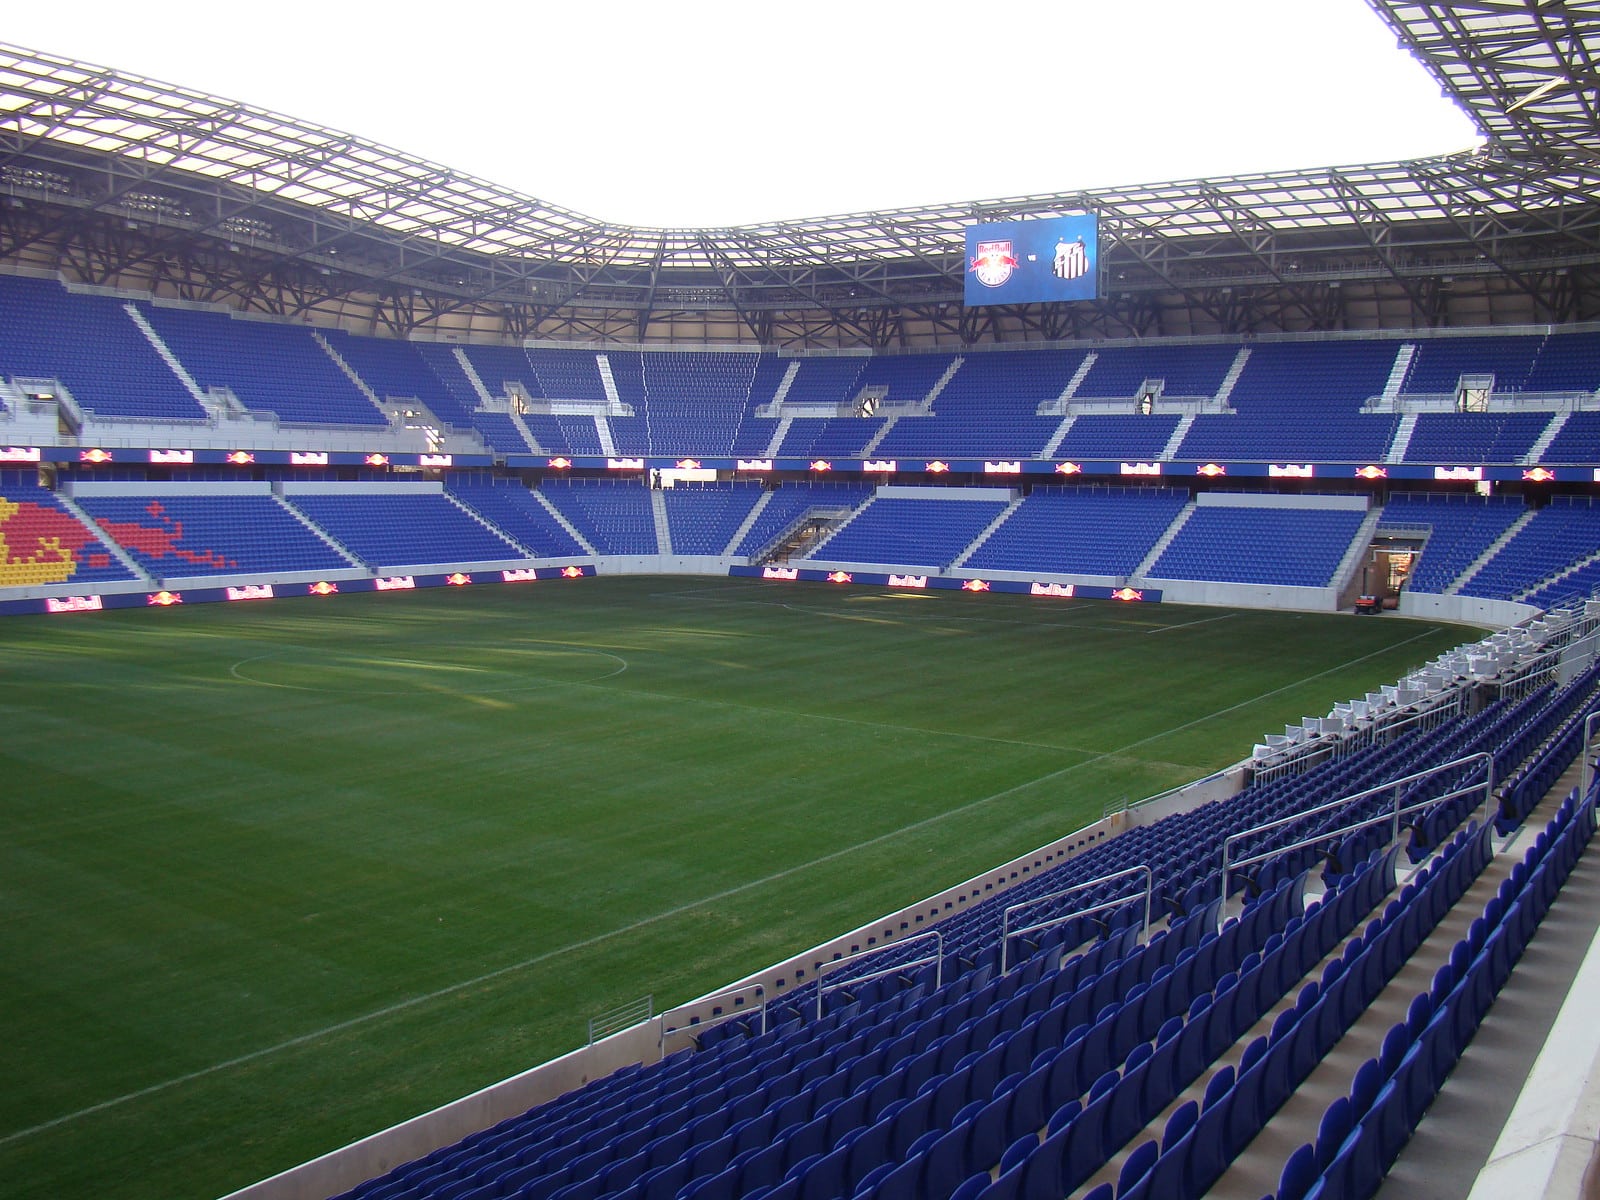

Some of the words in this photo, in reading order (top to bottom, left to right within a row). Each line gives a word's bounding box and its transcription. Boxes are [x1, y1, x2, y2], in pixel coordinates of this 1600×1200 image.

[1030, 582, 1052, 595] Red
[1052, 583, 1074, 597] Bull
[47, 597, 75, 612] Red
[75, 595, 102, 611] Bull
